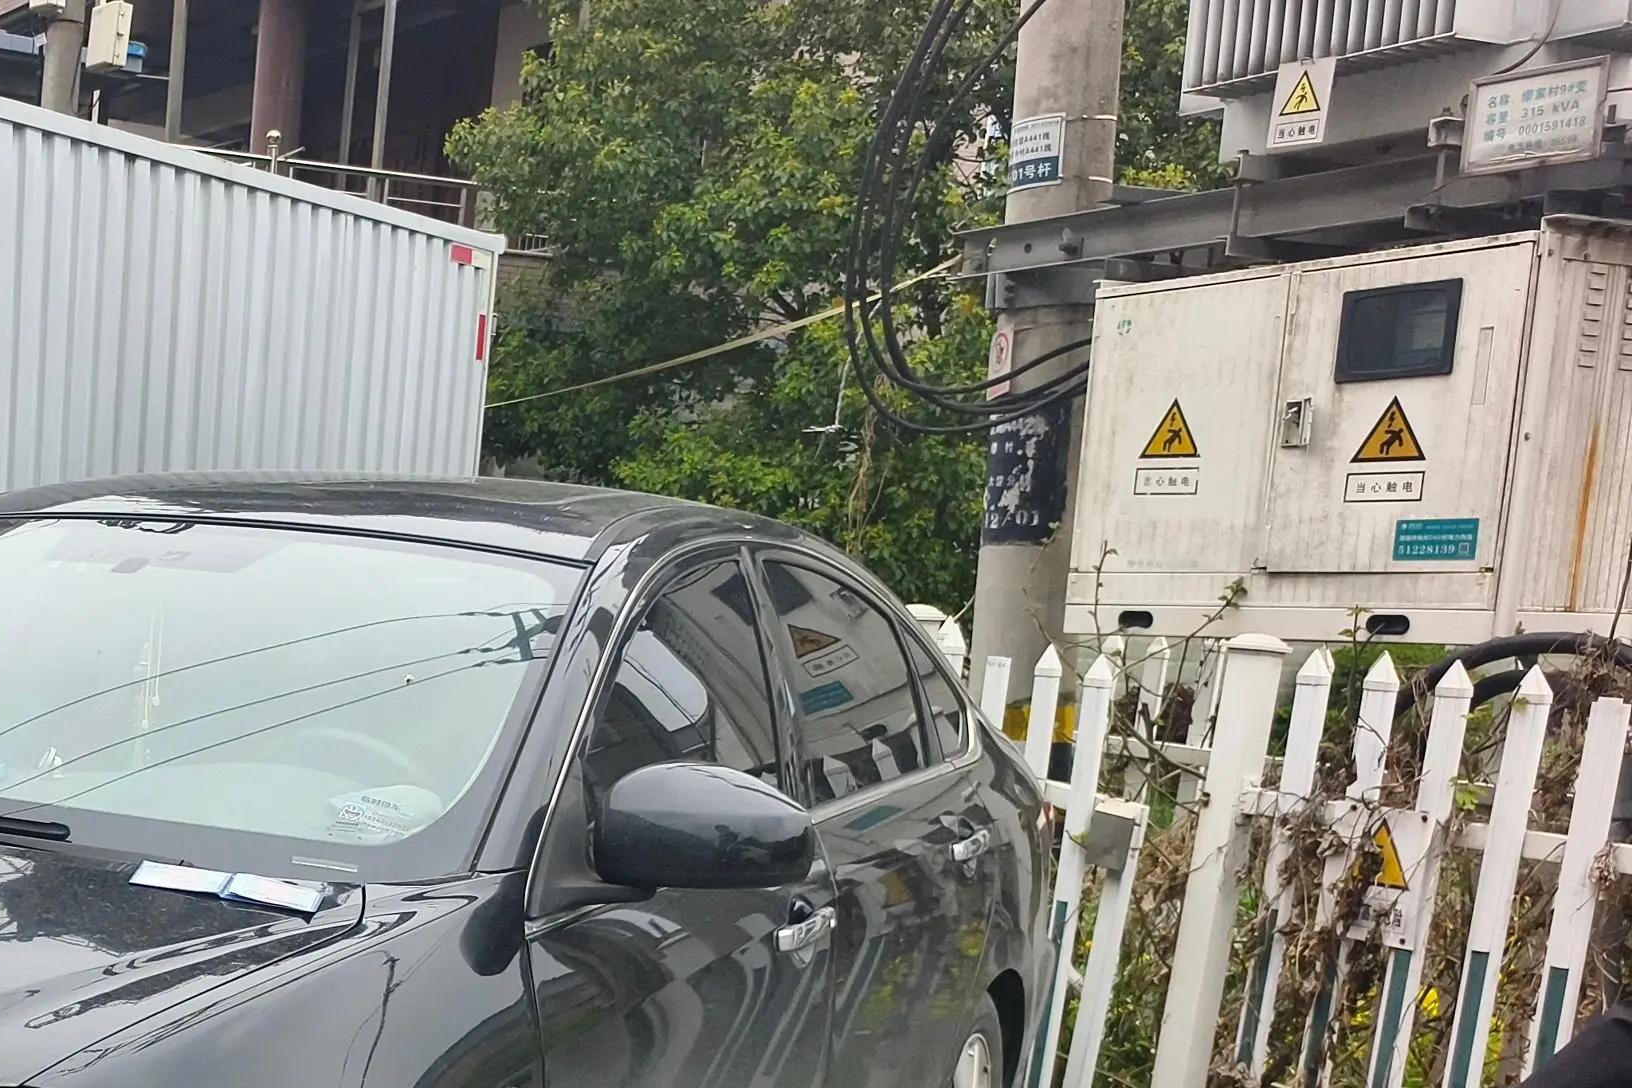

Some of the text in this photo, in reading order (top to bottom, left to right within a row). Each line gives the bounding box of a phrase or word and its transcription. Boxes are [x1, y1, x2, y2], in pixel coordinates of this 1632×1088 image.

[1521, 106, 1544, 119] 315
[1552, 100, 1580, 113] kVA
[1277, 125, 1316, 139] 当心触电
[1143, 476, 1190, 487] 当心触电
[1356, 481, 1413, 494] 当心触电
